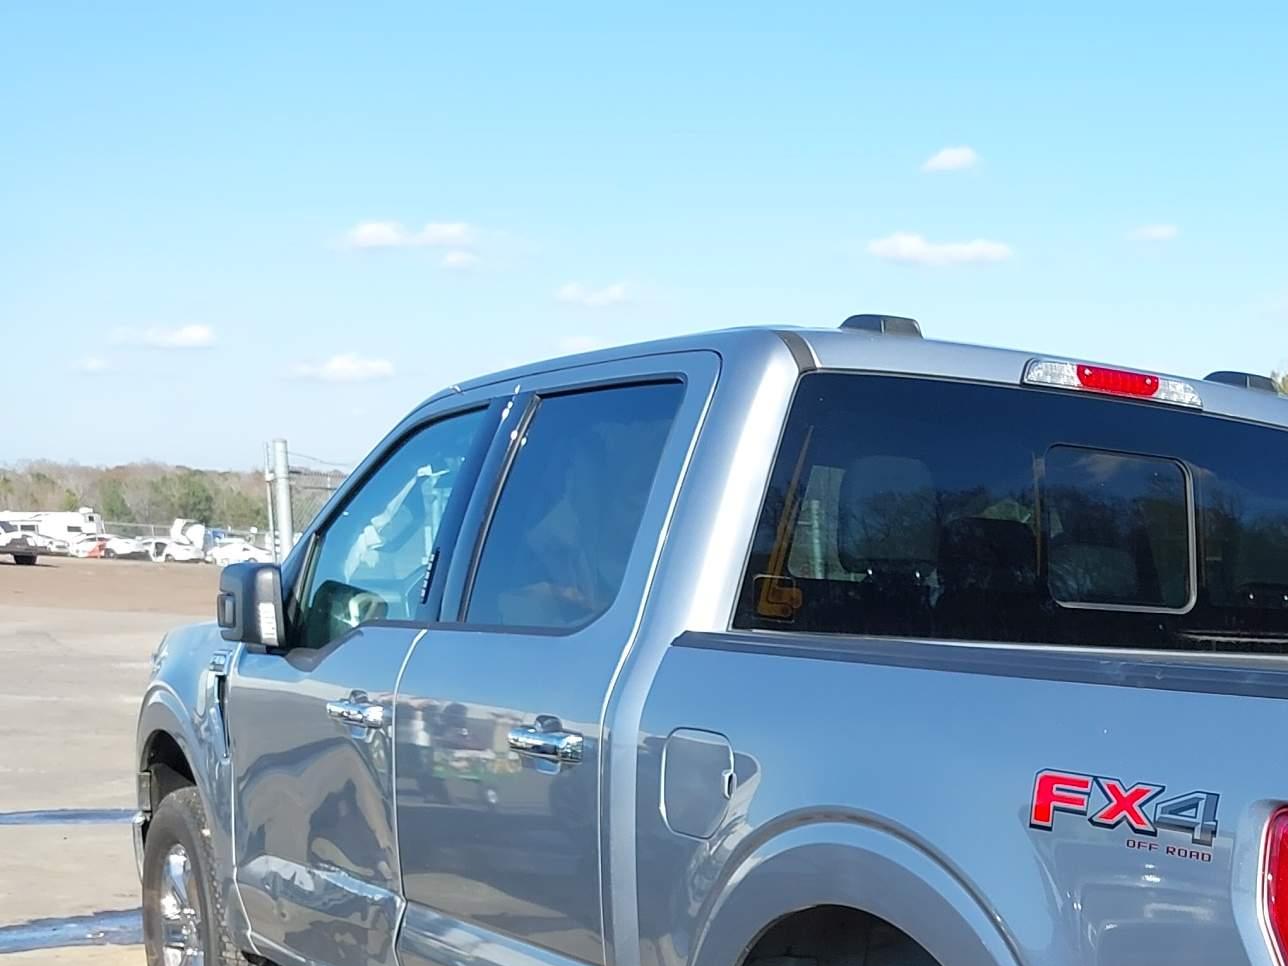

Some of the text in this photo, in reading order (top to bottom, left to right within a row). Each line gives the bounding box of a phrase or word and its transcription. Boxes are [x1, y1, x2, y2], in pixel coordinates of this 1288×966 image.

[1029, 768, 1220, 846] FX4
[1126, 839, 1213, 863] OFF ROAD
